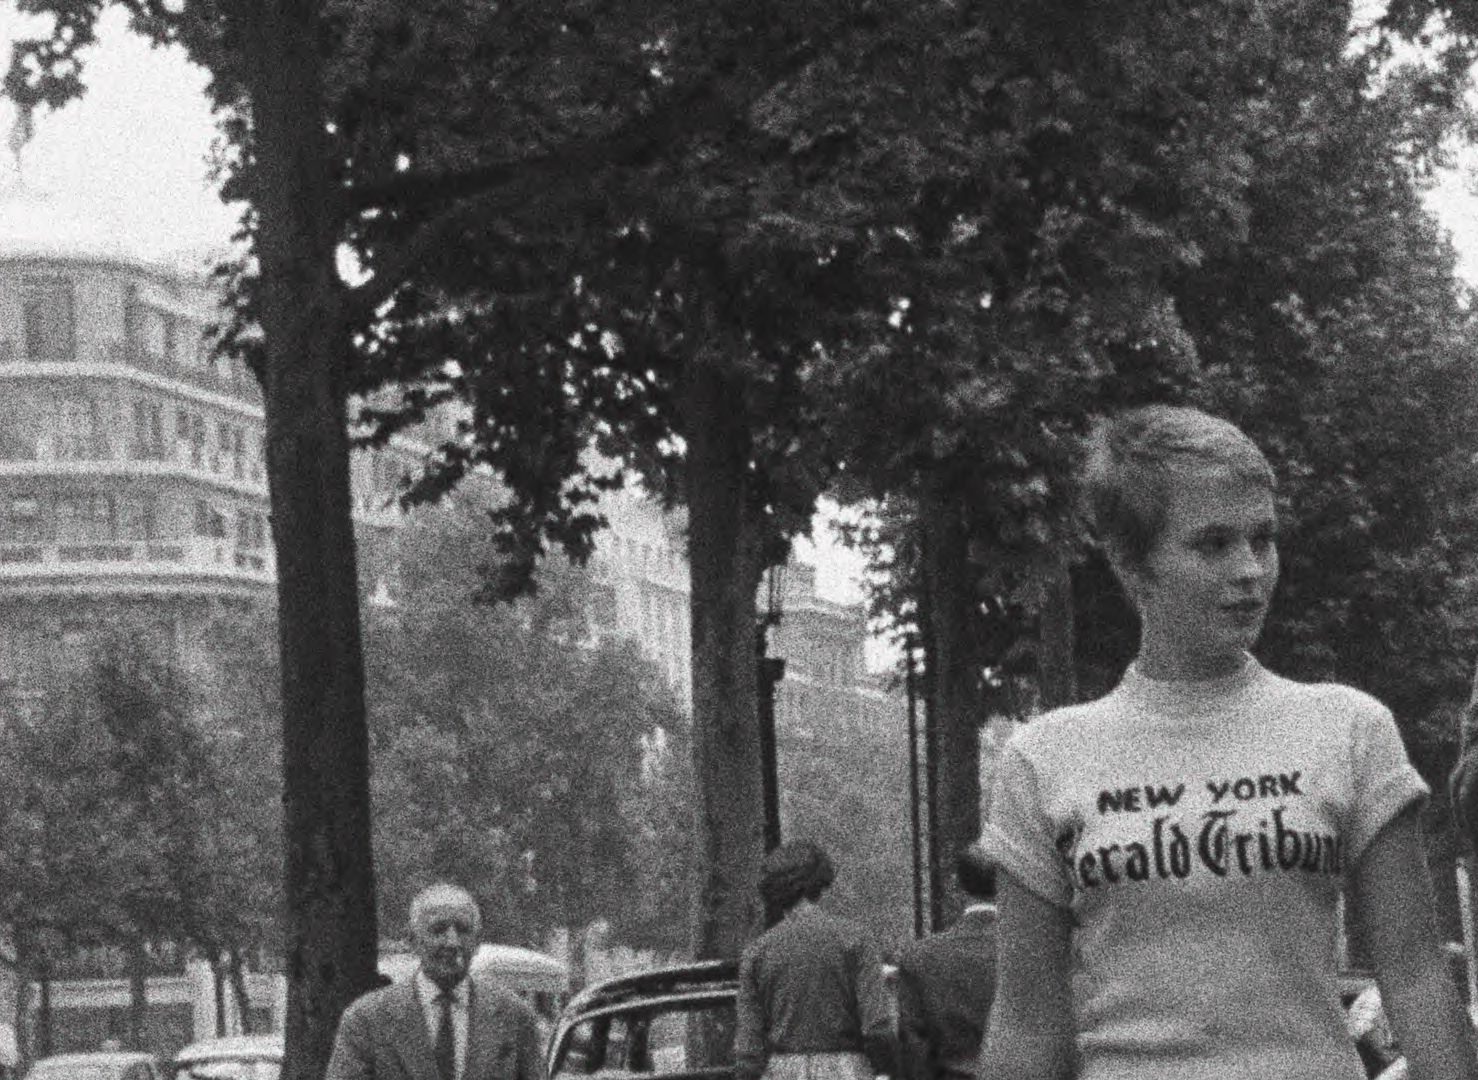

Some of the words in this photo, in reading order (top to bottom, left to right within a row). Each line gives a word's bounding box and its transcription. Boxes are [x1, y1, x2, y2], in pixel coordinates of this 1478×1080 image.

[1098, 783, 1185, 814] NEW
[1207, 771, 1302, 802] YORK
[1199, 806, 1342, 877] Tribun
